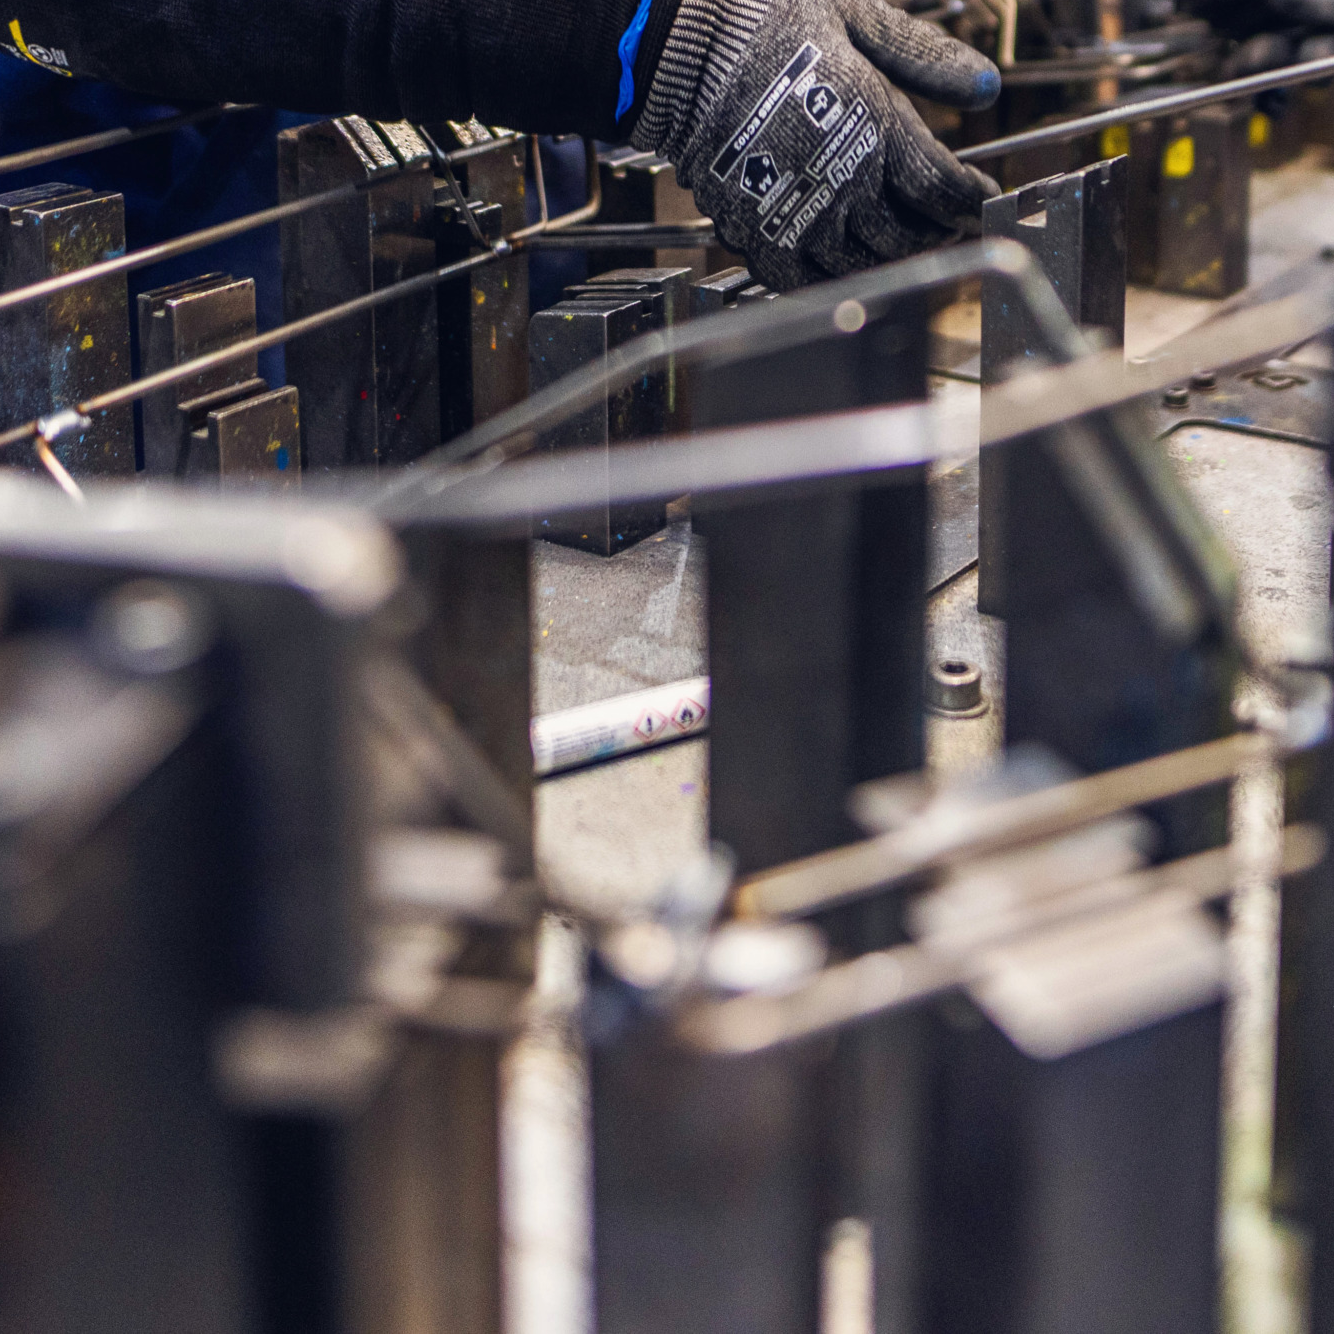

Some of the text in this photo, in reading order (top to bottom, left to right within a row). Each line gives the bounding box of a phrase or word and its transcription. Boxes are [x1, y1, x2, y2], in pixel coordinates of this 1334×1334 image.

[732, 74, 791, 151] SERIES EC103
[743, 176, 752, 187] 3
[757, 172, 773, 193] A4
[778, 189, 801, 216] SIZE:
